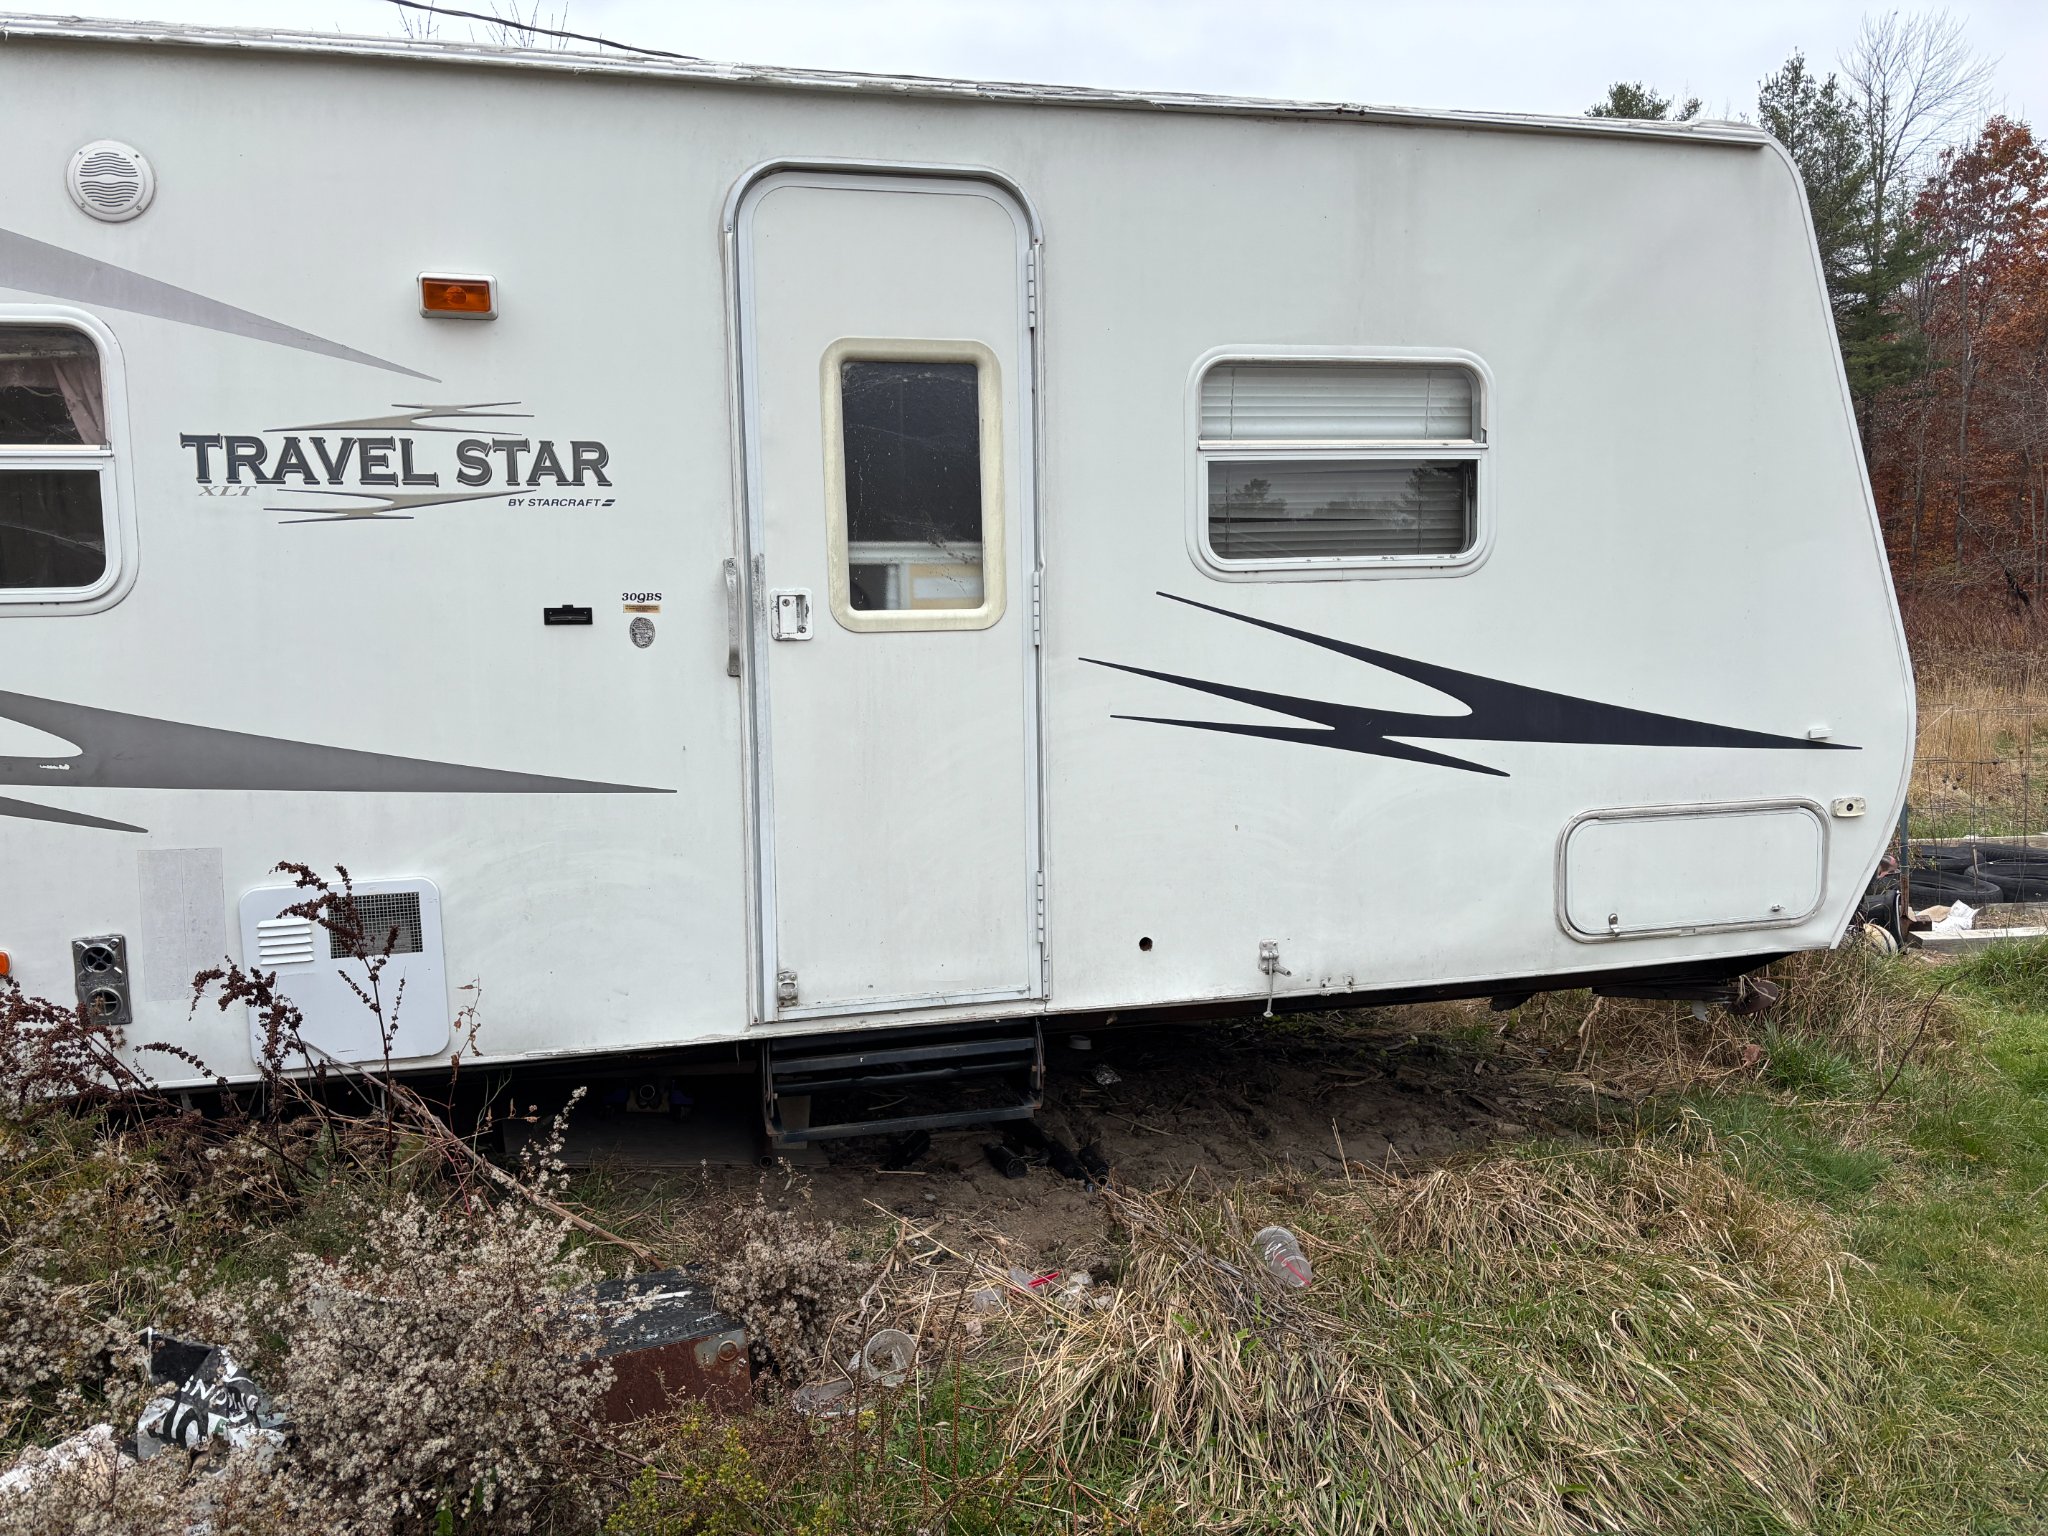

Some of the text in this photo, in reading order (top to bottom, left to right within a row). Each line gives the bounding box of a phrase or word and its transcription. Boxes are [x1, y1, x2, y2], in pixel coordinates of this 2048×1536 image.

[179, 432, 613, 487] TRAVEL STAR
[197, 484, 257, 497] XLT
[508, 498, 601, 507] BY STARCRAFT
[621, 592, 662, 603] 30QBS
